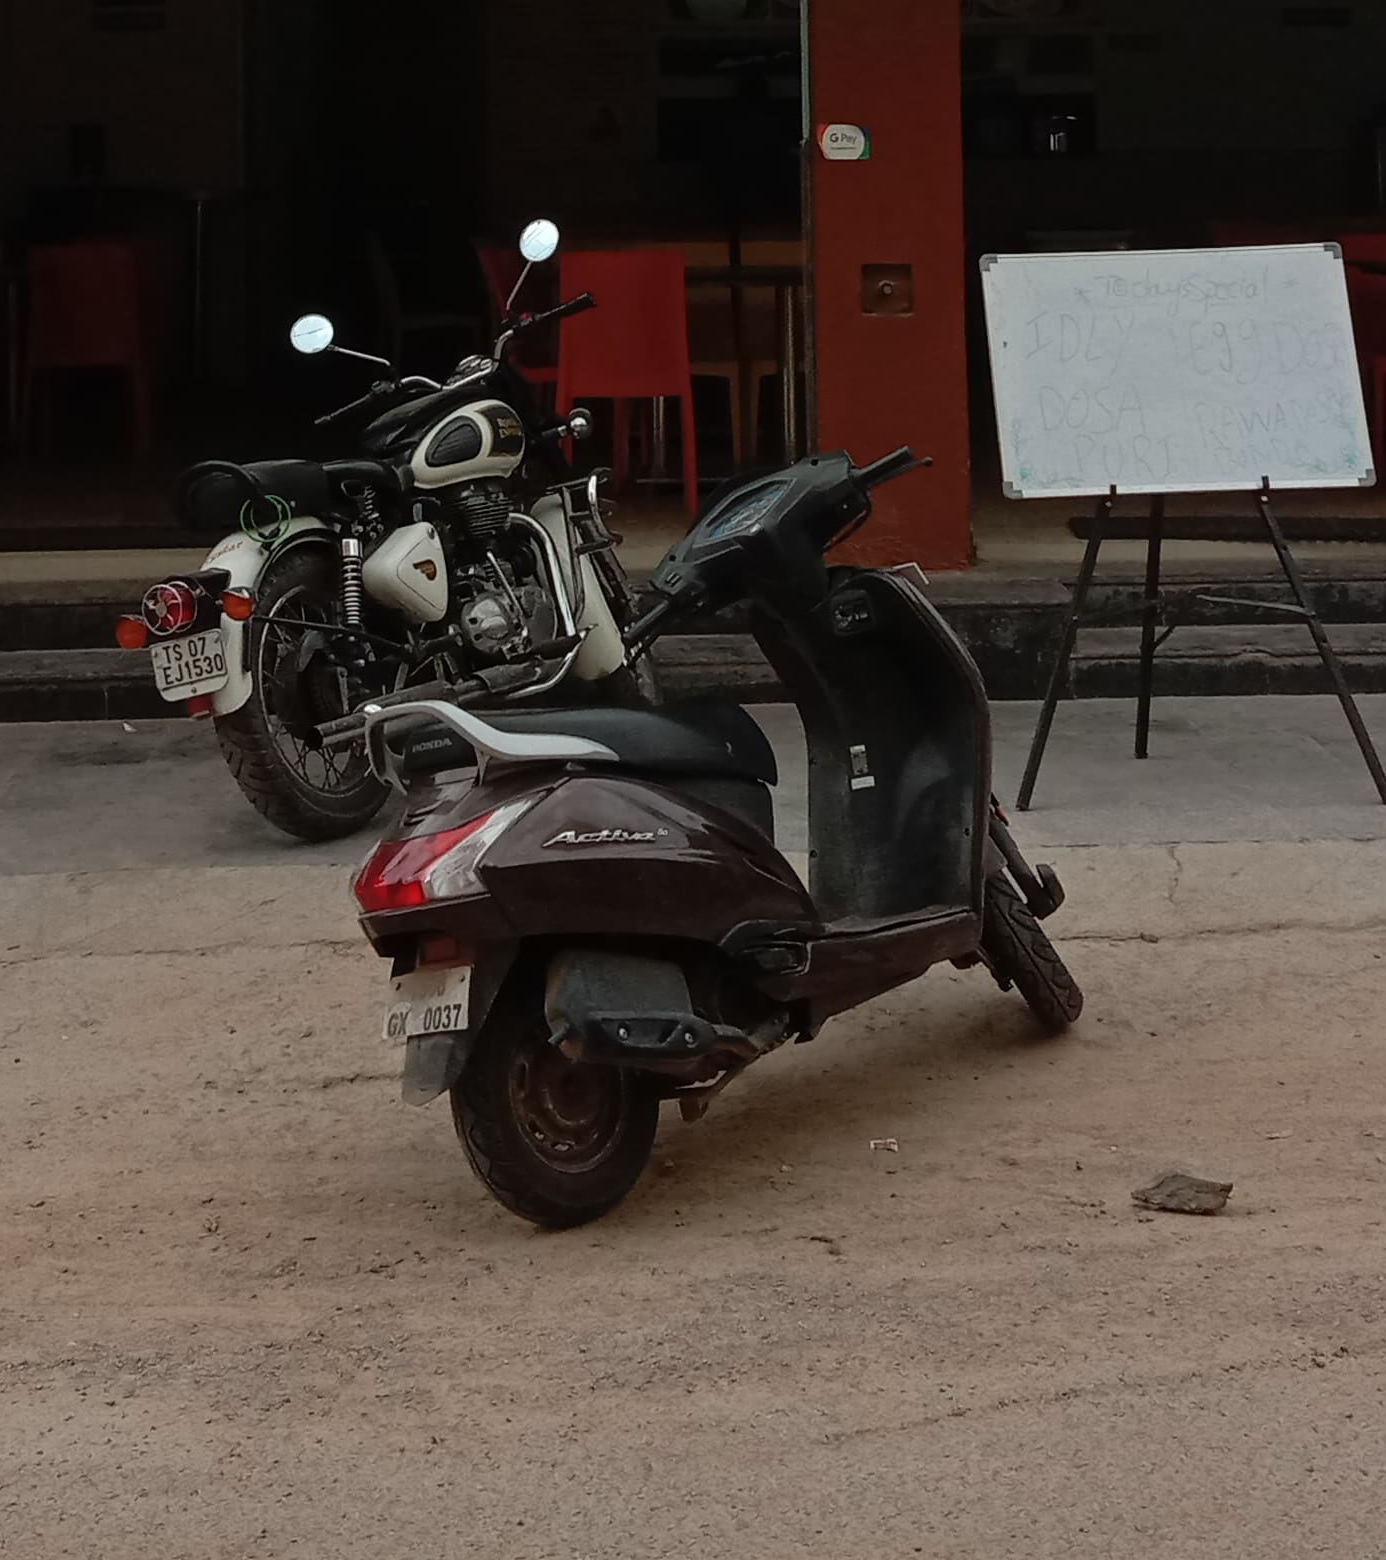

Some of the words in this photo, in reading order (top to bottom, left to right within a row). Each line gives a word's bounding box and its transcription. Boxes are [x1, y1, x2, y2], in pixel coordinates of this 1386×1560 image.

[162, 643, 183, 665] TS
[188, 636, 206, 658] 07
[163, 653, 224, 685] EJ1530
[423, 1003, 462, 1031] 0037
